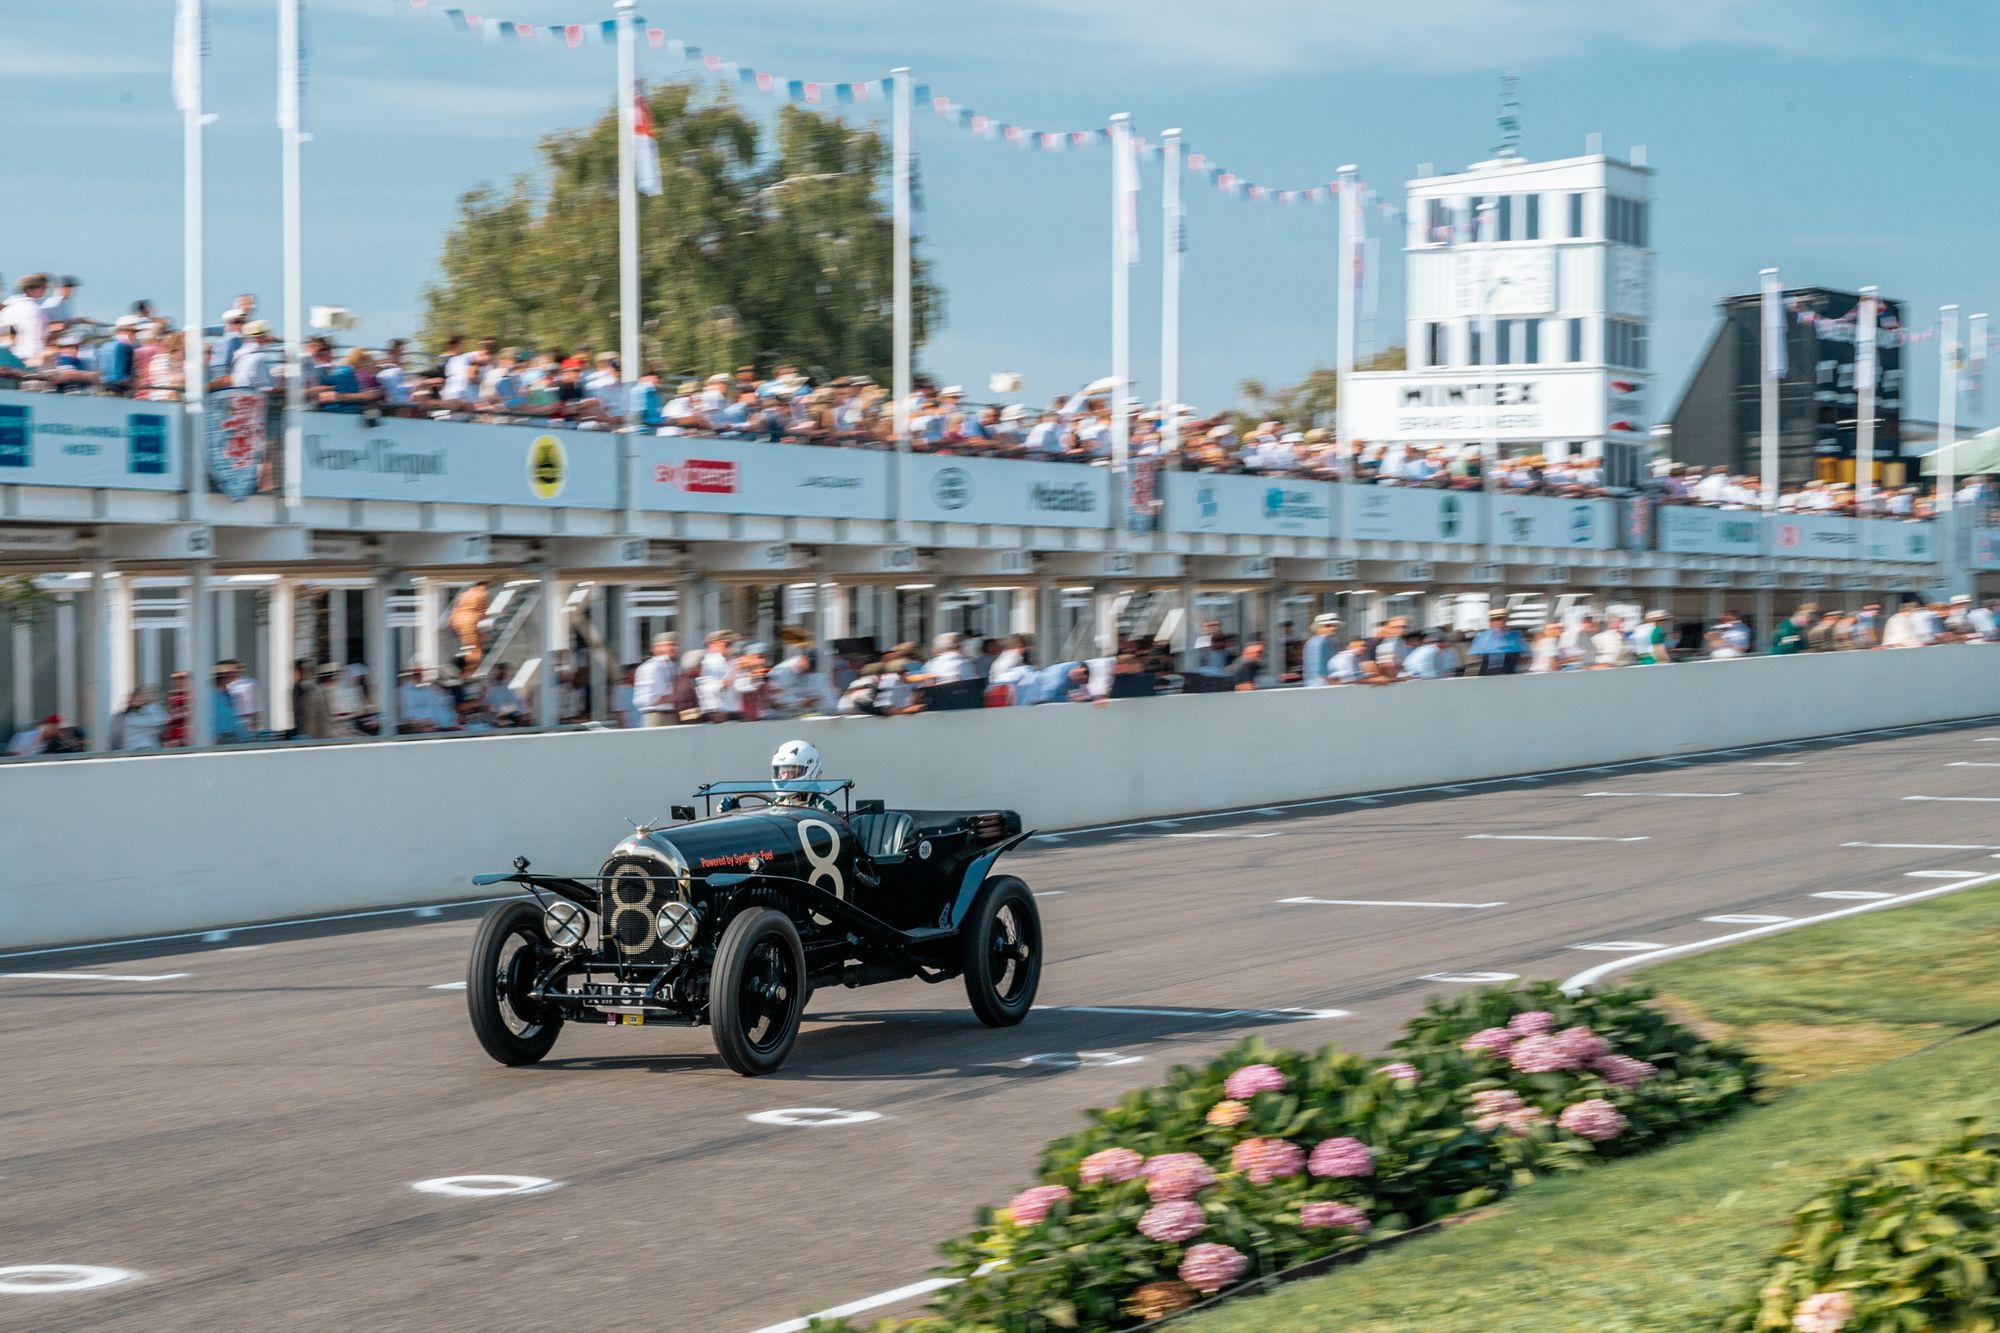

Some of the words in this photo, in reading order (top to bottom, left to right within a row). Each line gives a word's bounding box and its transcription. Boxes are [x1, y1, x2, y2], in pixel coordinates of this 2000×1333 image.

[700, 855, 726, 868] Powered
[726, 854, 734, 866] by
[760, 849, 774, 861] Fuel
[797, 818, 845, 926] 8
[610, 863, 657, 955] 8
[620, 986, 669, 1006] 671
